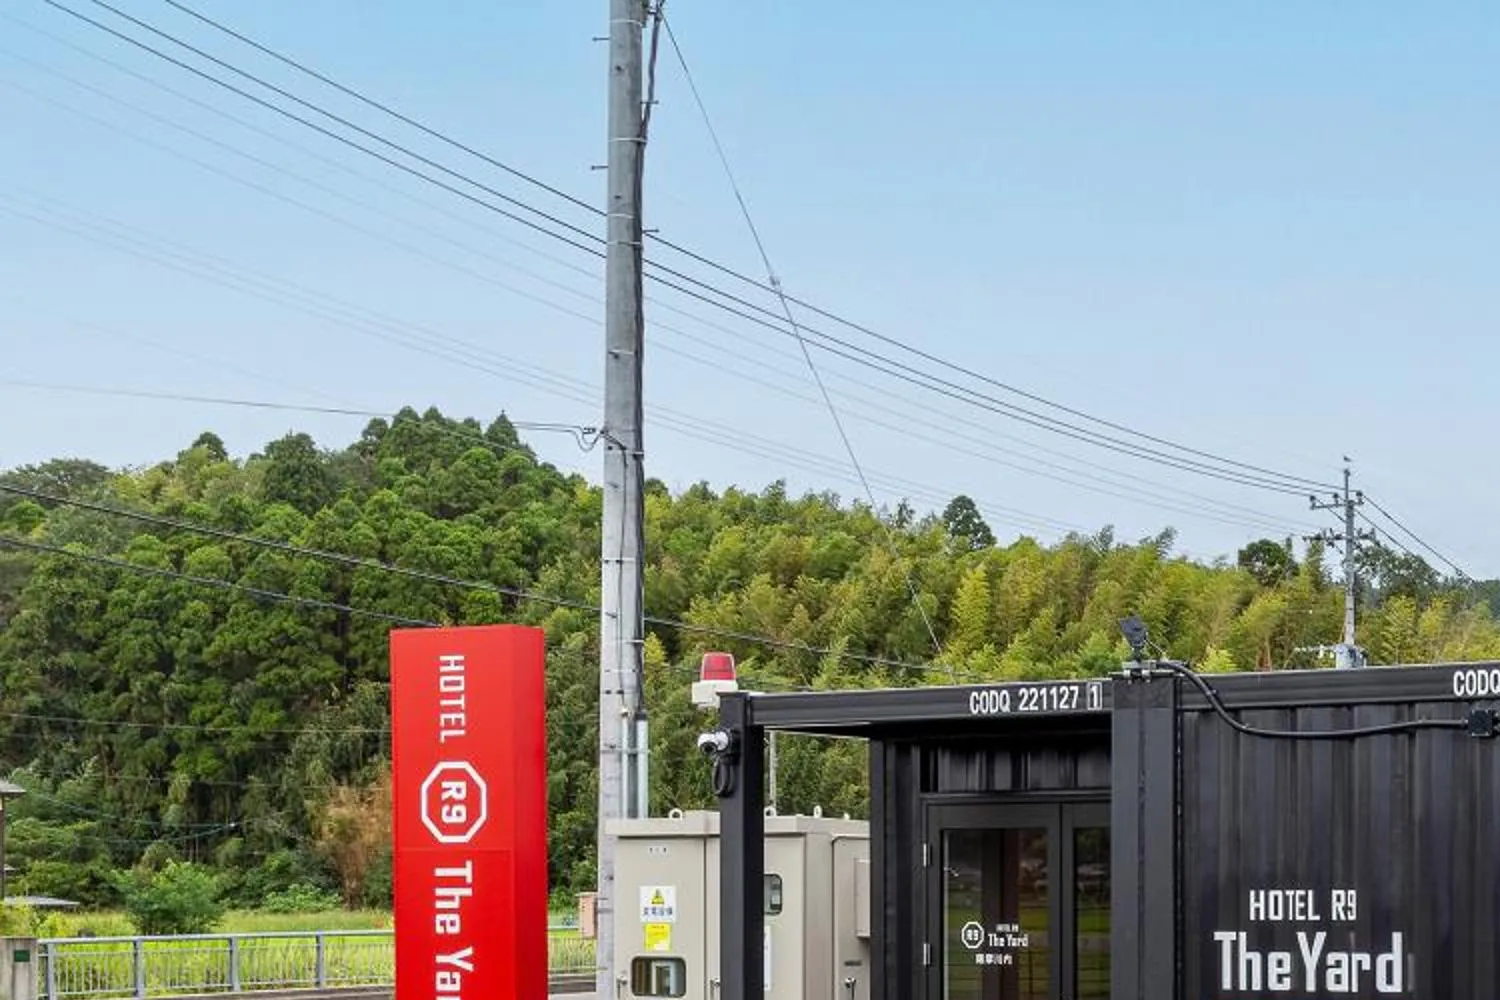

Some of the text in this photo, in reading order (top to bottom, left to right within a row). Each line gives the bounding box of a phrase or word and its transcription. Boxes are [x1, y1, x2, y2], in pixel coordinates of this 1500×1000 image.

[439, 655, 466, 744] HOTEL
[969, 689, 1011, 715] CODQ
[1018, 685, 1079, 711] 221127
[440, 780, 468, 824] R9
[434, 859, 473, 935] The
[1249, 889, 1358, 921] HOTEL R9
[988, 933, 1029, 947] The Yard
[1213, 931, 1403, 993] The Yard
